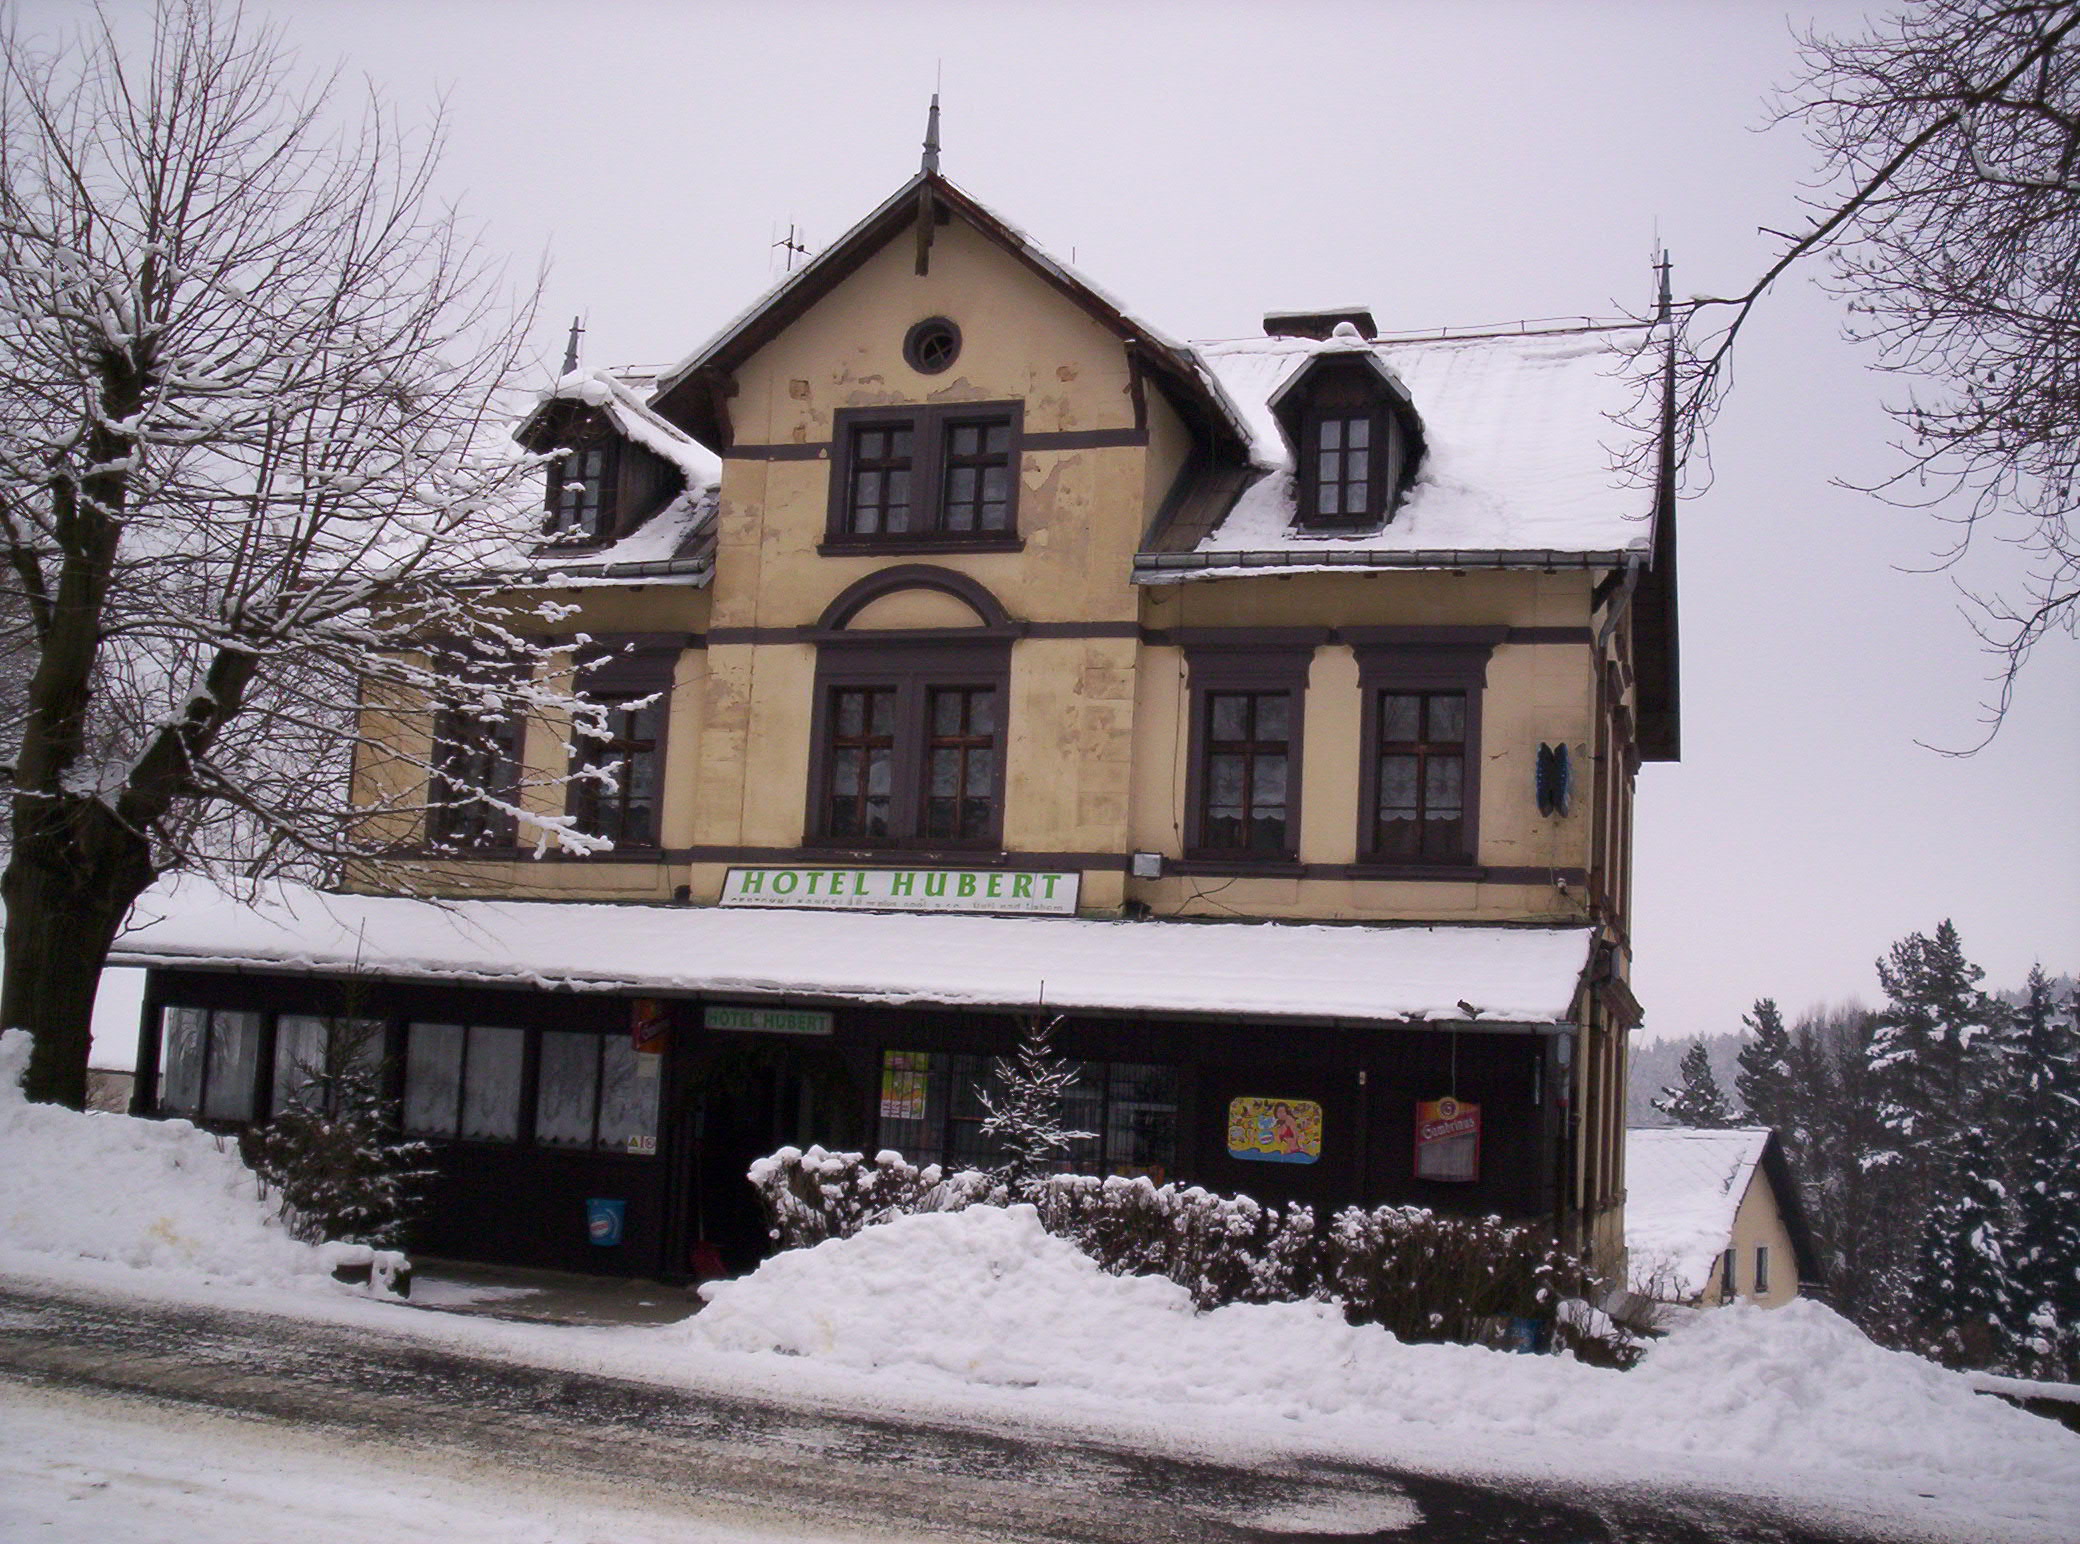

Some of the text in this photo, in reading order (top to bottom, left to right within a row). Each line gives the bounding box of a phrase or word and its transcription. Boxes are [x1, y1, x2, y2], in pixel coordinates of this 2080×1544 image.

[740, 871, 1061, 899] HOTEL HUBERT
[706, 1010, 829, 1032] HOTEL HUBERT
